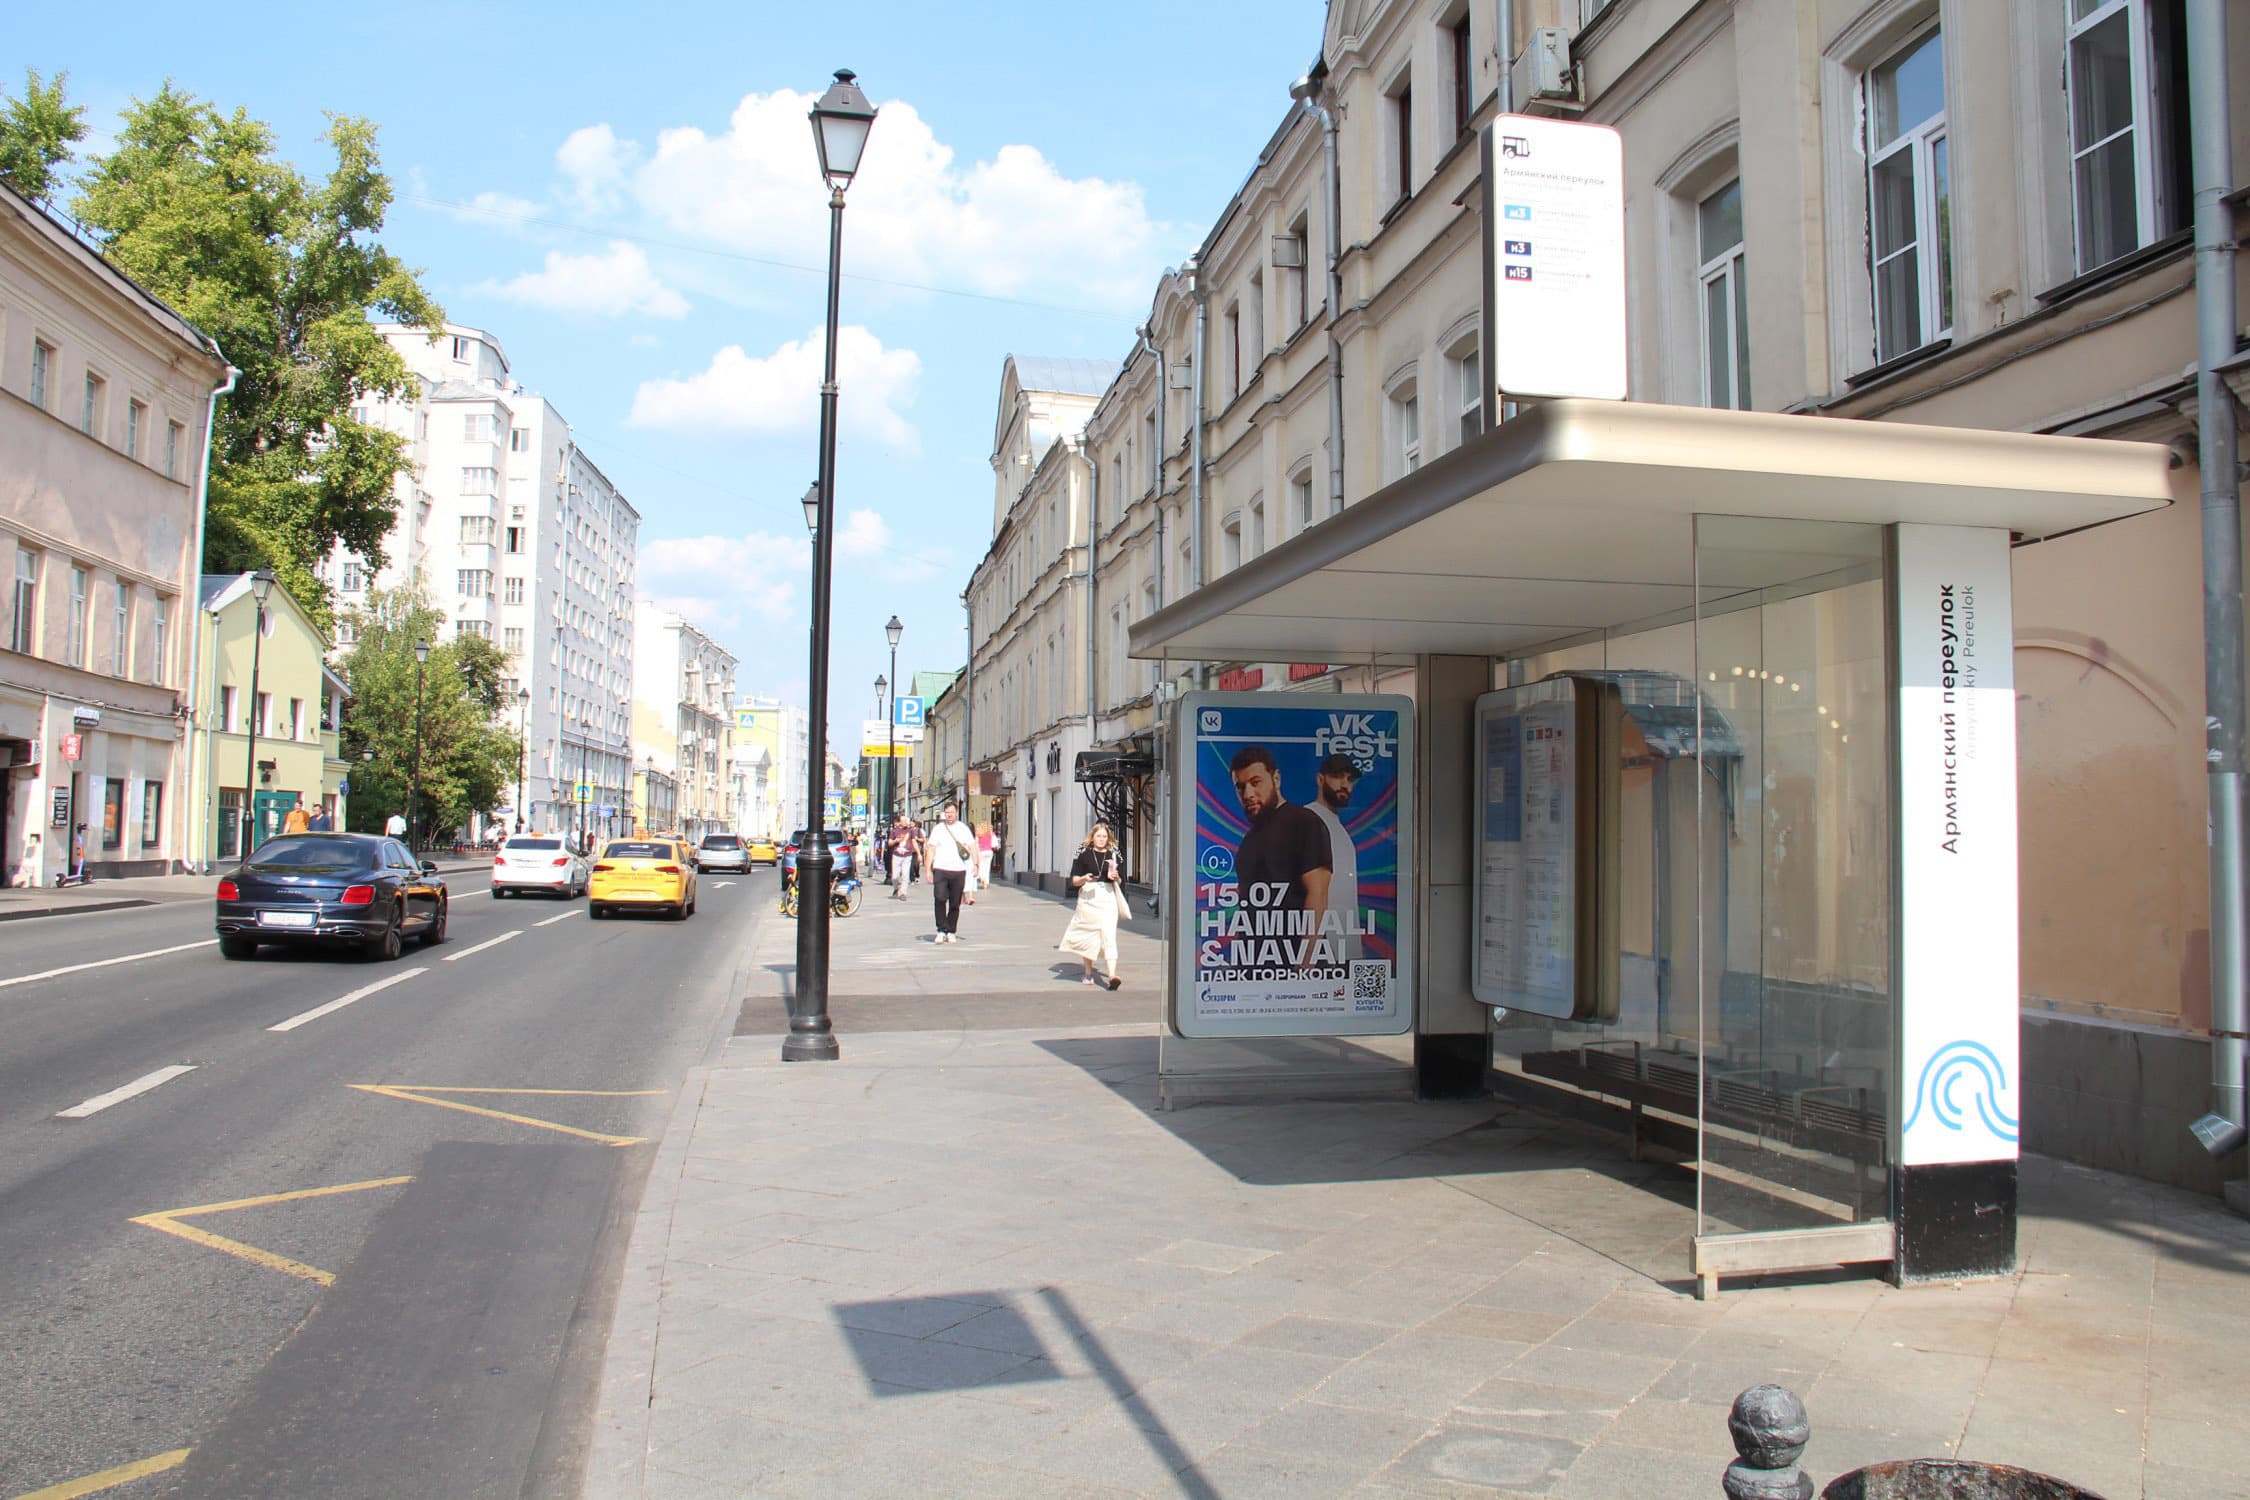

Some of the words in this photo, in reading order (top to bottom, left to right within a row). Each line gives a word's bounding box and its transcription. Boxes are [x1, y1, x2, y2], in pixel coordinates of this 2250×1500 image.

[1503, 166, 1558, 181] Армянский
[1560, 172, 1605, 187] переулок
[1962, 585, 1975, 658] Pereulok
[1940, 583, 1959, 704] переулок
[1204, 716, 1218, 727] VK
[1328, 713, 1375, 735] VK
[1315, 727, 1393, 758] fest
[1941, 713, 1960, 855] Армянский
[1208, 855, 1228, 870] 0+
[1200, 882, 1290, 907] 15.07
[1200, 909, 1376, 937] HAMMALI
[1200, 969, 1249, 983] ПАРК
[1252, 967, 1346, 982] ГОРЬКОГО
